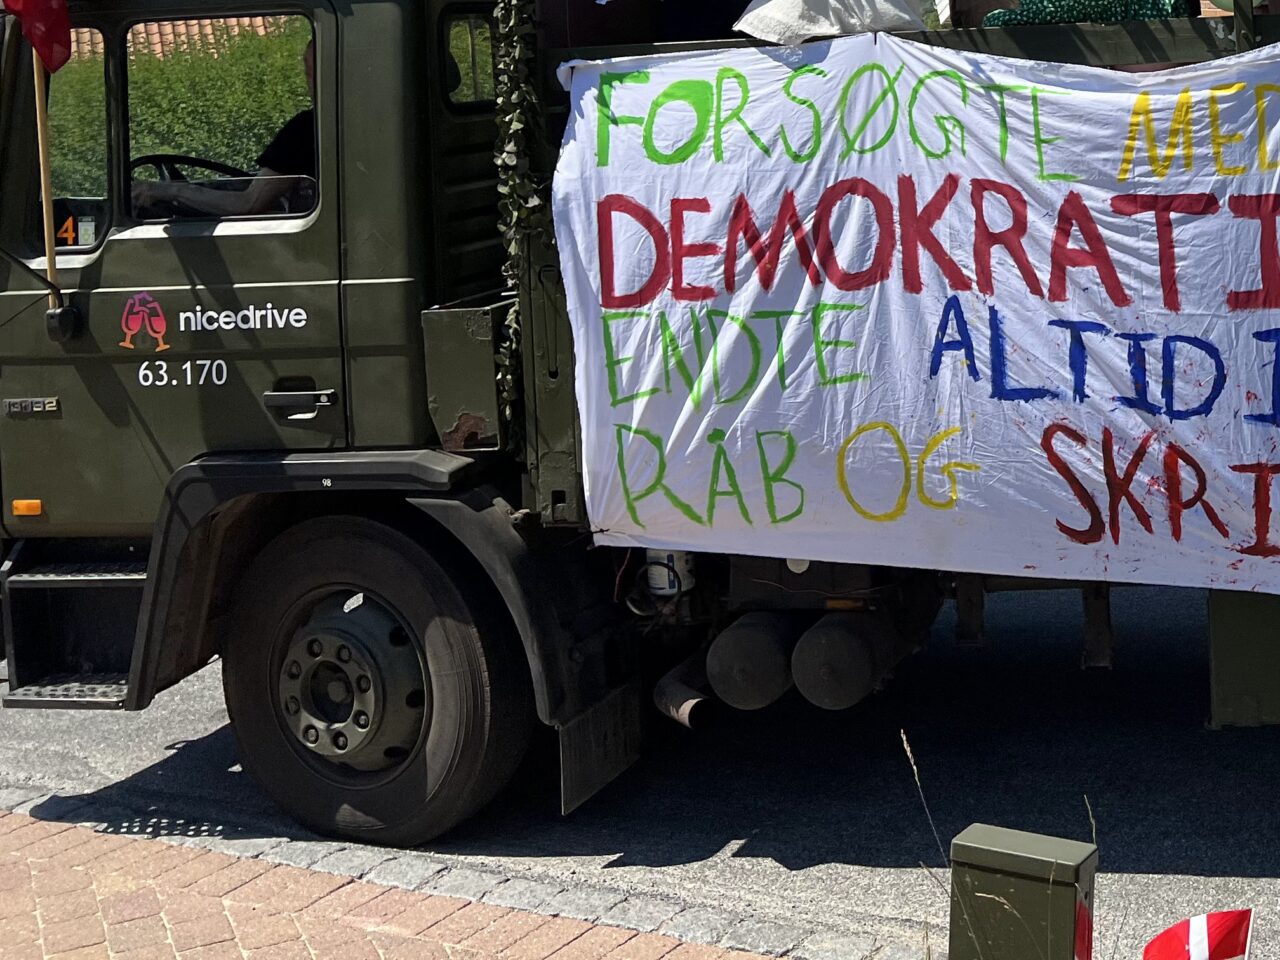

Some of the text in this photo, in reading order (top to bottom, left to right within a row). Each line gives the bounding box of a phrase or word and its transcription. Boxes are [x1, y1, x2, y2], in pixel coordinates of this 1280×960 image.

[596, 62, 1081, 181] FORSØGTE
[179, 302, 307, 331] nicedrive
[138, 359, 228, 386] 63.170
[601, 301, 871, 411] ENDTE
[929, 295, 1227, 423] ALTID
[321, 478, 332, 487] 98
[613, 423, 804, 529] RÅB
[836, 421, 981, 522] OG
